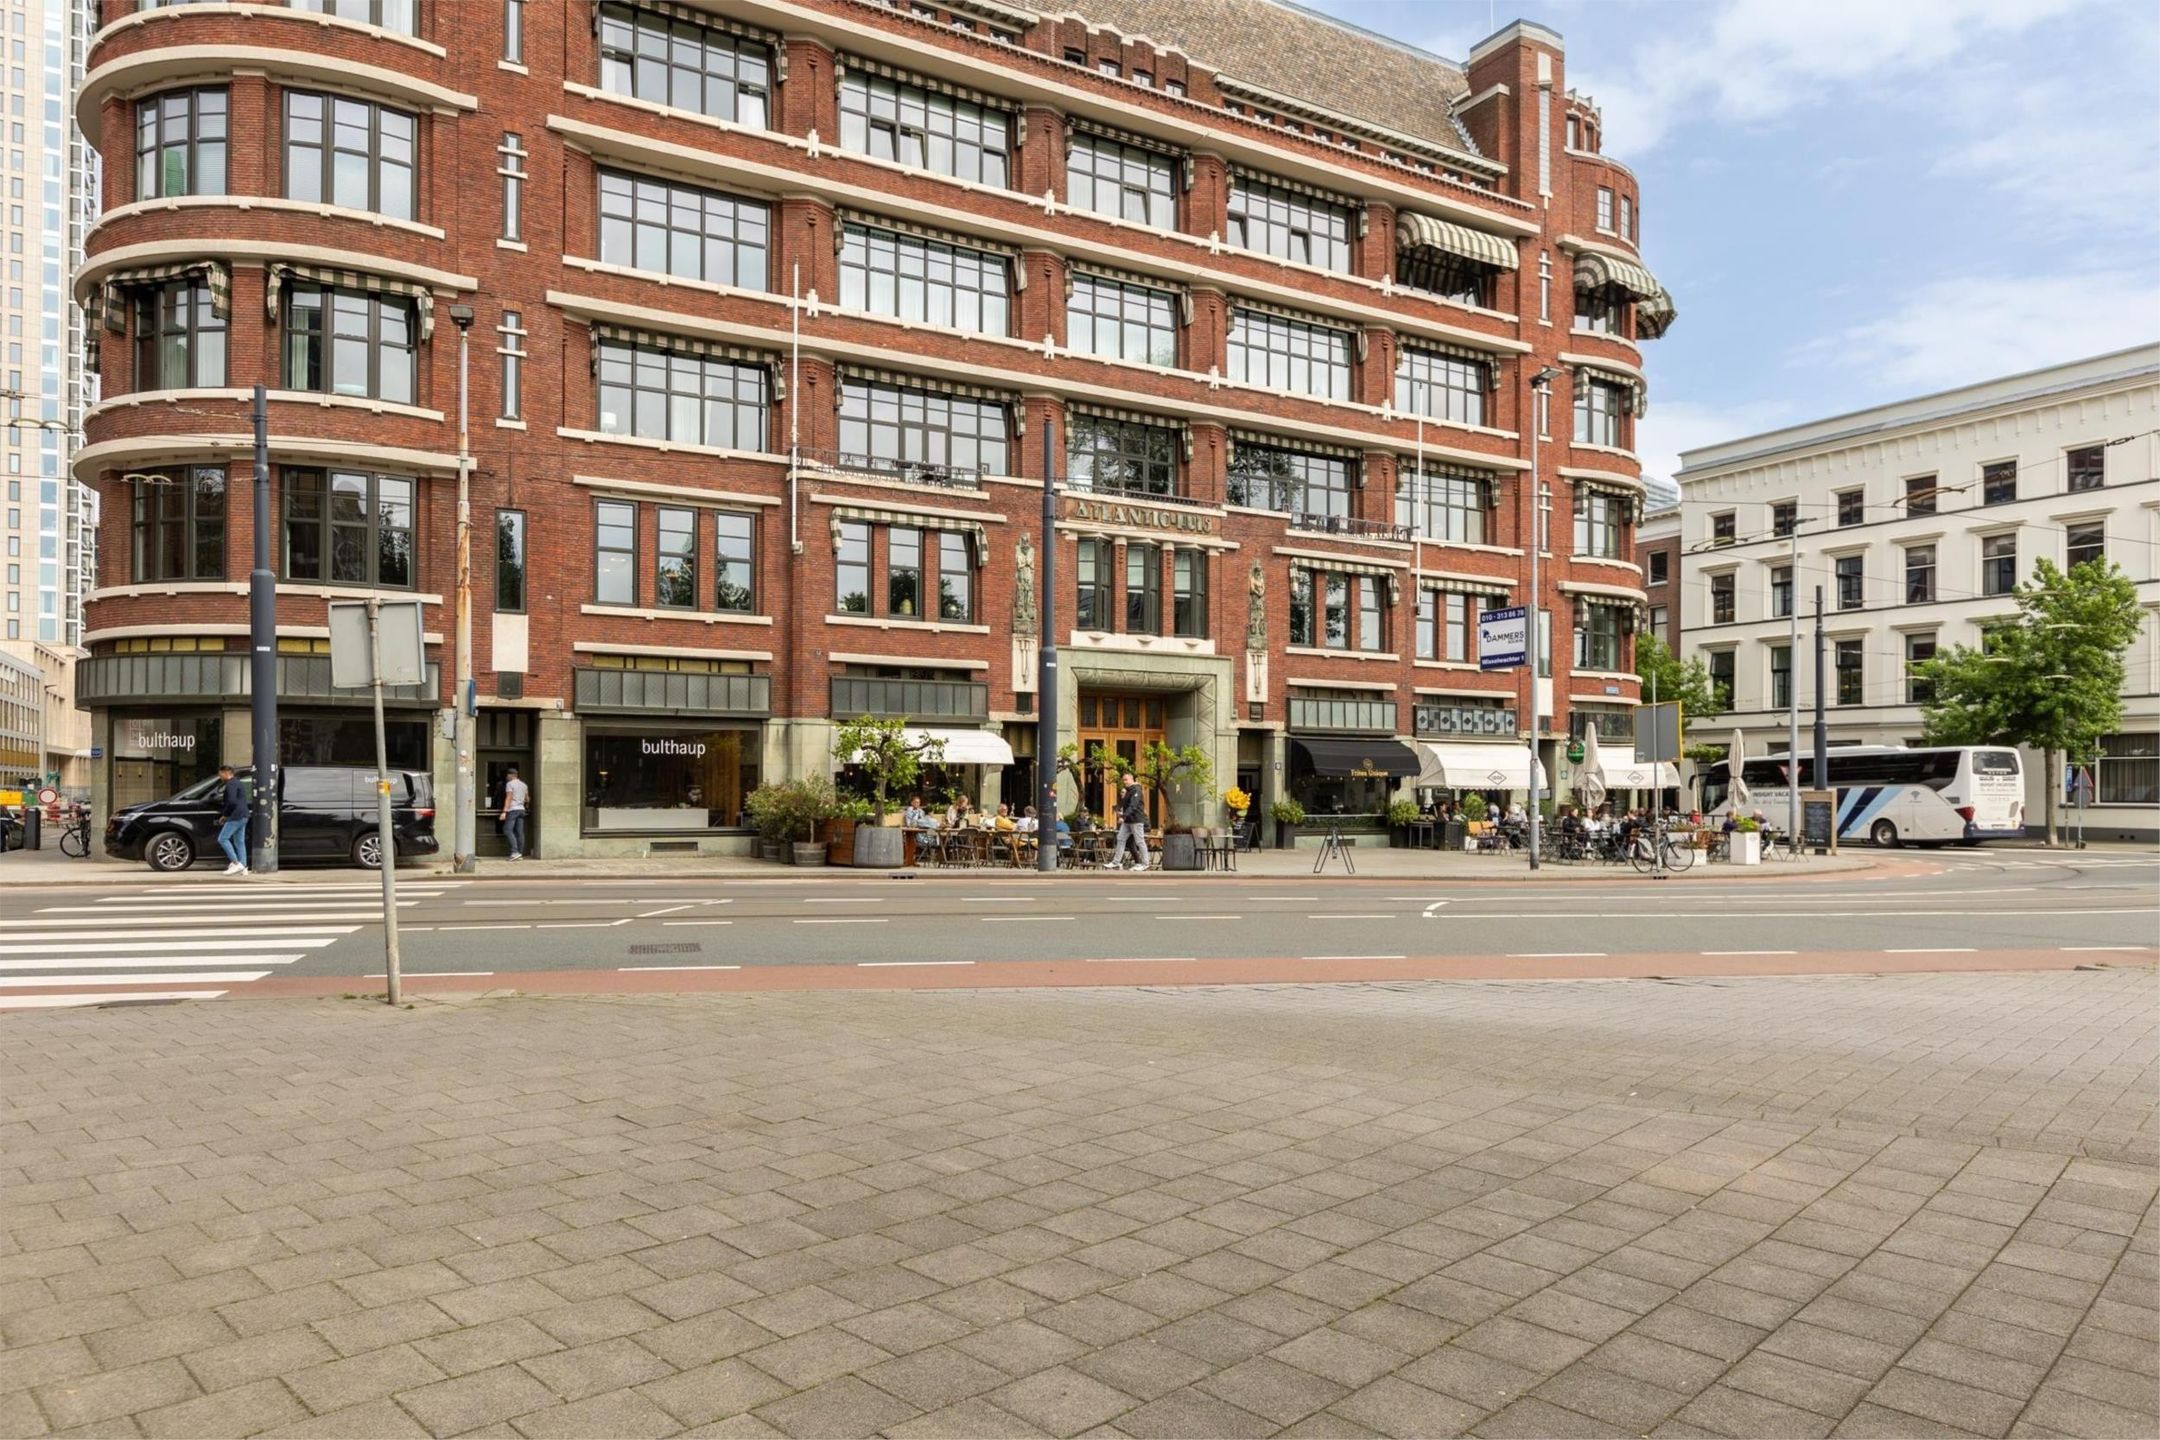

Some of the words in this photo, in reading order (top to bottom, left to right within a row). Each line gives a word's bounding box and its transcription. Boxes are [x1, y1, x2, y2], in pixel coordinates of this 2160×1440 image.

[1486, 630, 1525, 643] DAMMERS
[138, 731, 196, 752] bulthaup
[642, 738, 706, 759] bulthaup
